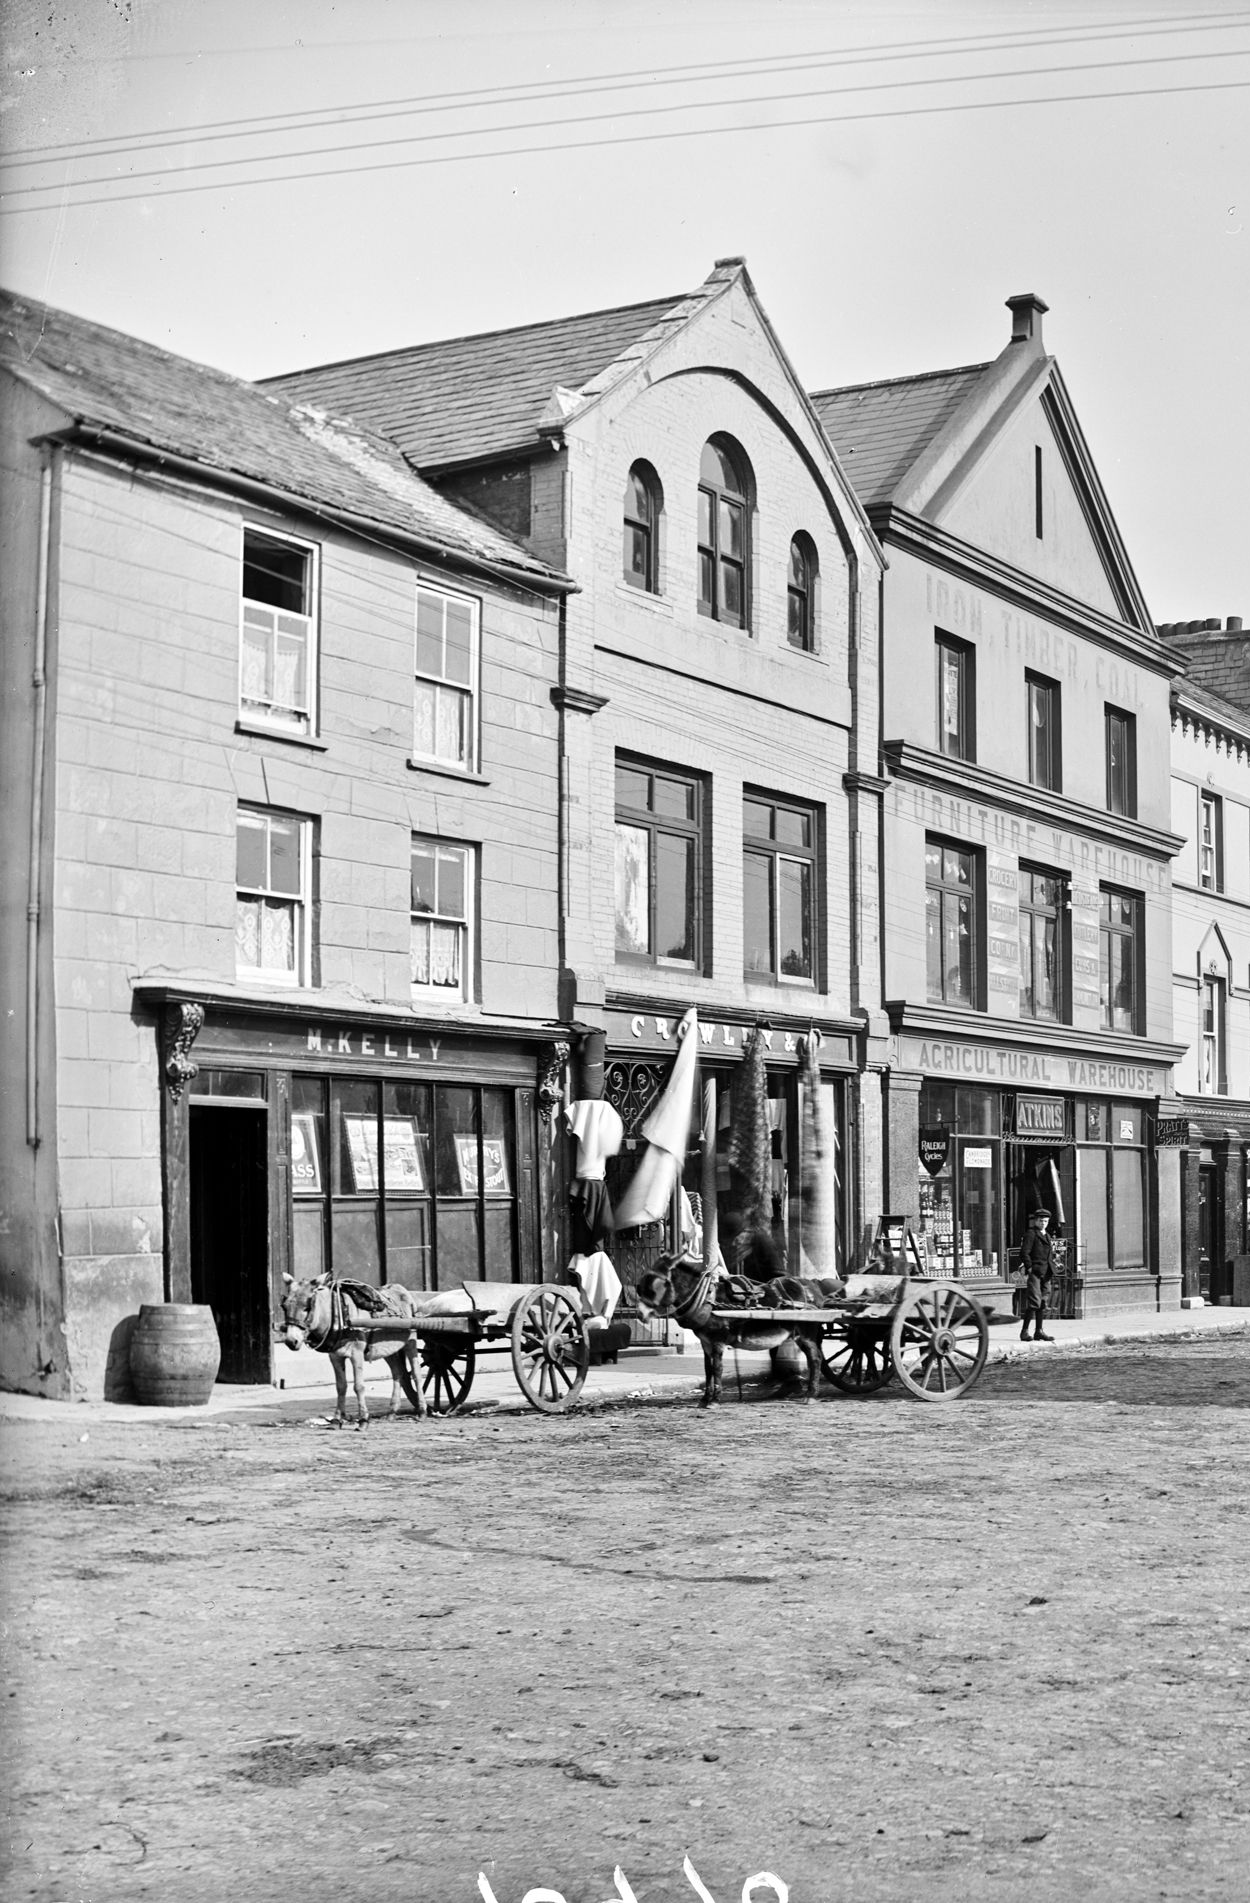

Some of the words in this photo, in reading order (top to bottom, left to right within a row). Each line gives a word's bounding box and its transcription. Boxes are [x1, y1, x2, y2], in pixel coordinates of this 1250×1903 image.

[894, 784, 1037, 854] FURNITURE
[1051, 832, 1167, 893] WAREHOUSE
[785, 1032, 796, 1051] &
[919, 1042, 1050, 1081] AGRICULTURAL
[1067, 1060, 1154, 1092] WAREHOUSE
[1018, 1102, 1063, 1129] ATKINS
[1160, 1136, 1187, 1146] SPIRIT
[924, 1152, 943, 1162] Cycles
[291, 1164, 315, 1178] ASS
